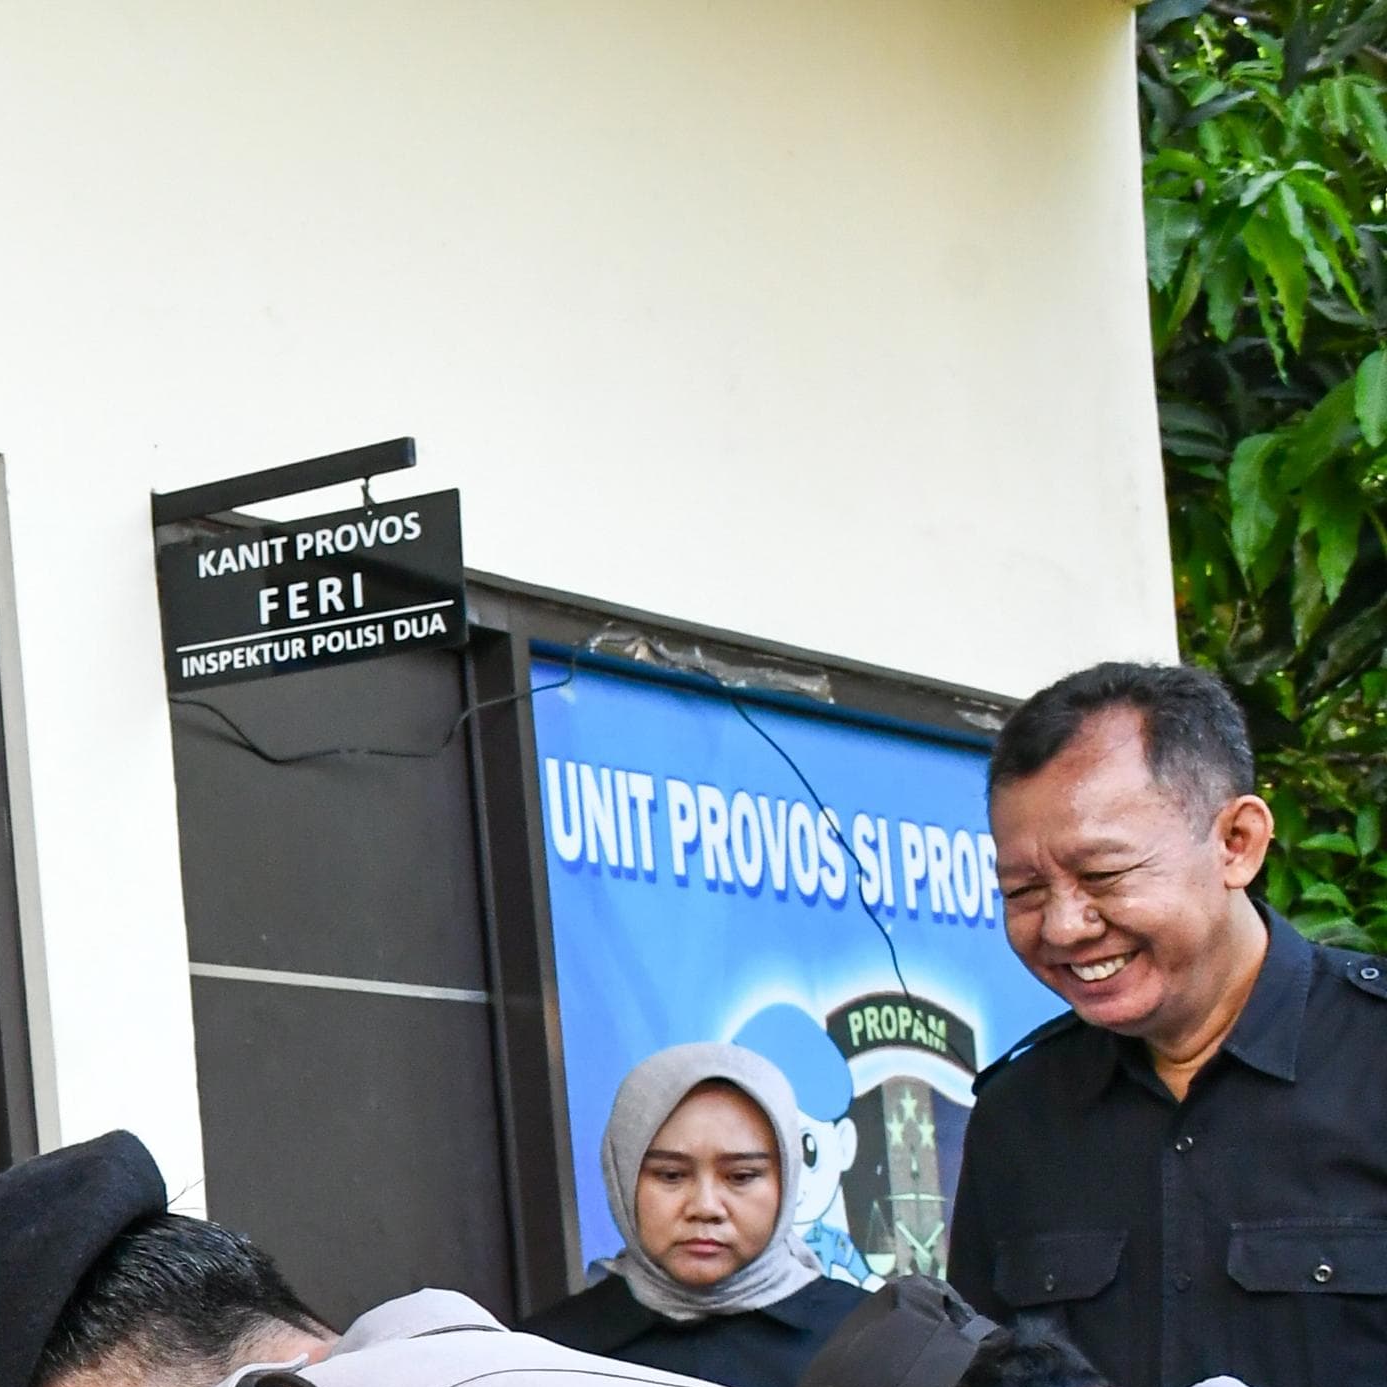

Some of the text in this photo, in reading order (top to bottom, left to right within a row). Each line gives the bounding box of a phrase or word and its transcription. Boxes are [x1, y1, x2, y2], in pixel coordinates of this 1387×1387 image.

[198, 511, 422, 579] KANIT PROVOS
[258, 571, 364, 625] FERI
[181, 612, 447, 678] INSPEKTUR POLISI DUA
[545, 757, 655, 872] UNIT
[665, 777, 847, 901] PROVOS
[852, 812, 895, 908] SI
[847, 1005, 948, 1052] PROPAM
